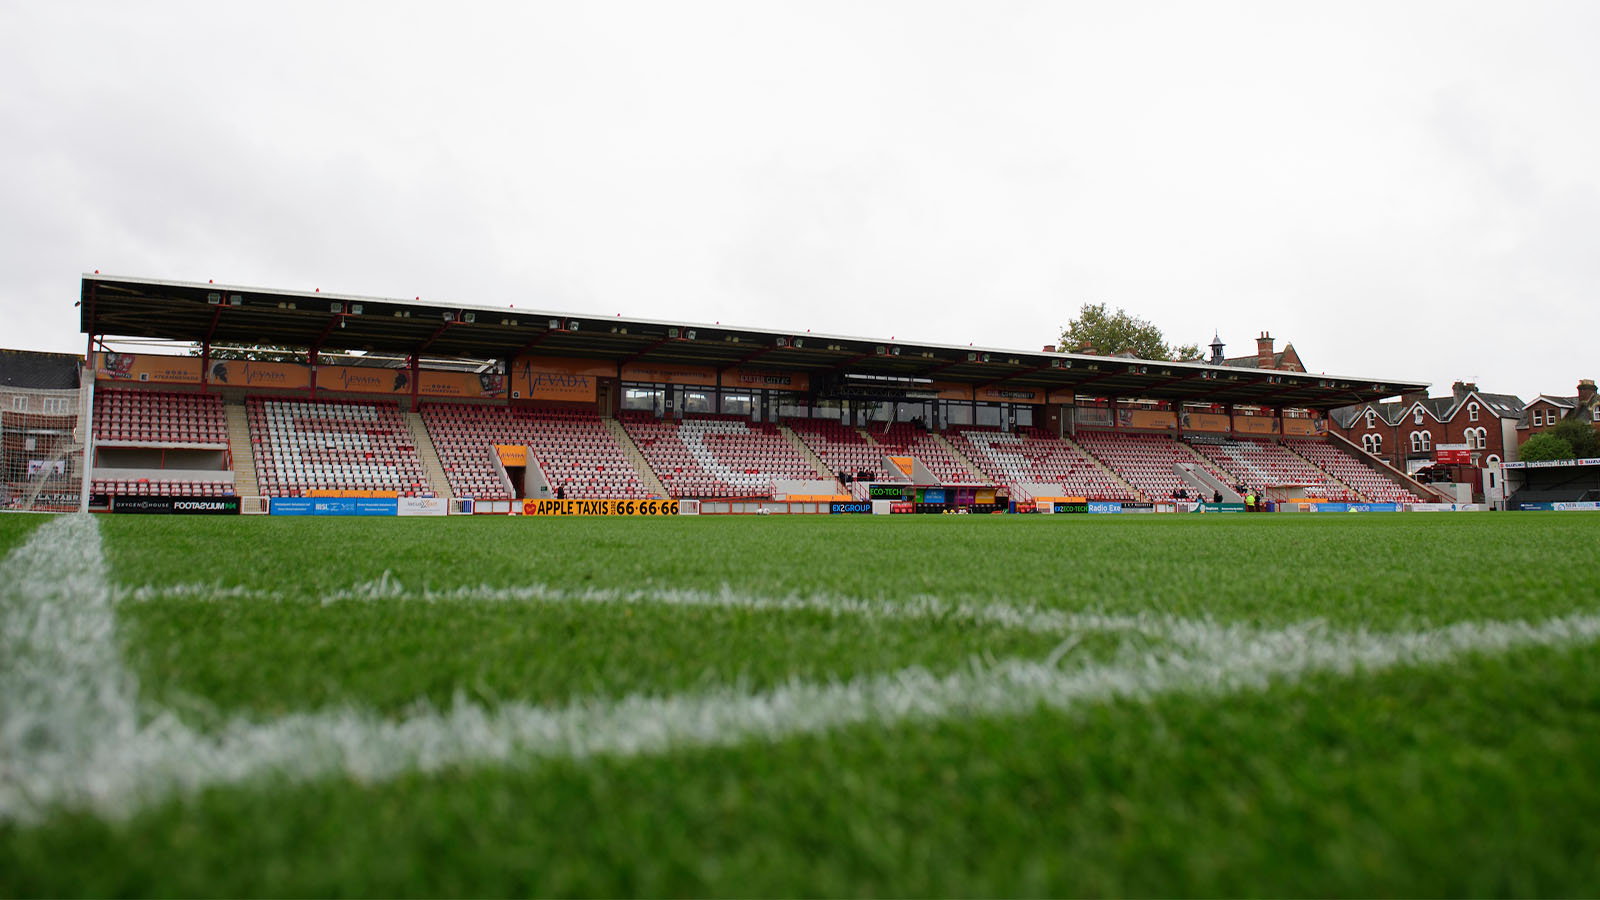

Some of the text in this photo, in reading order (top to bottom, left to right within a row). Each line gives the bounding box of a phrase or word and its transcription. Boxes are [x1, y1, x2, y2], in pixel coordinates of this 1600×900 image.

[537, 501, 574, 515] APPLE
[576, 501, 609, 515] TAXIS
[1088, 504, 1108, 512] Radio
[1109, 504, 1121, 512] Exe
